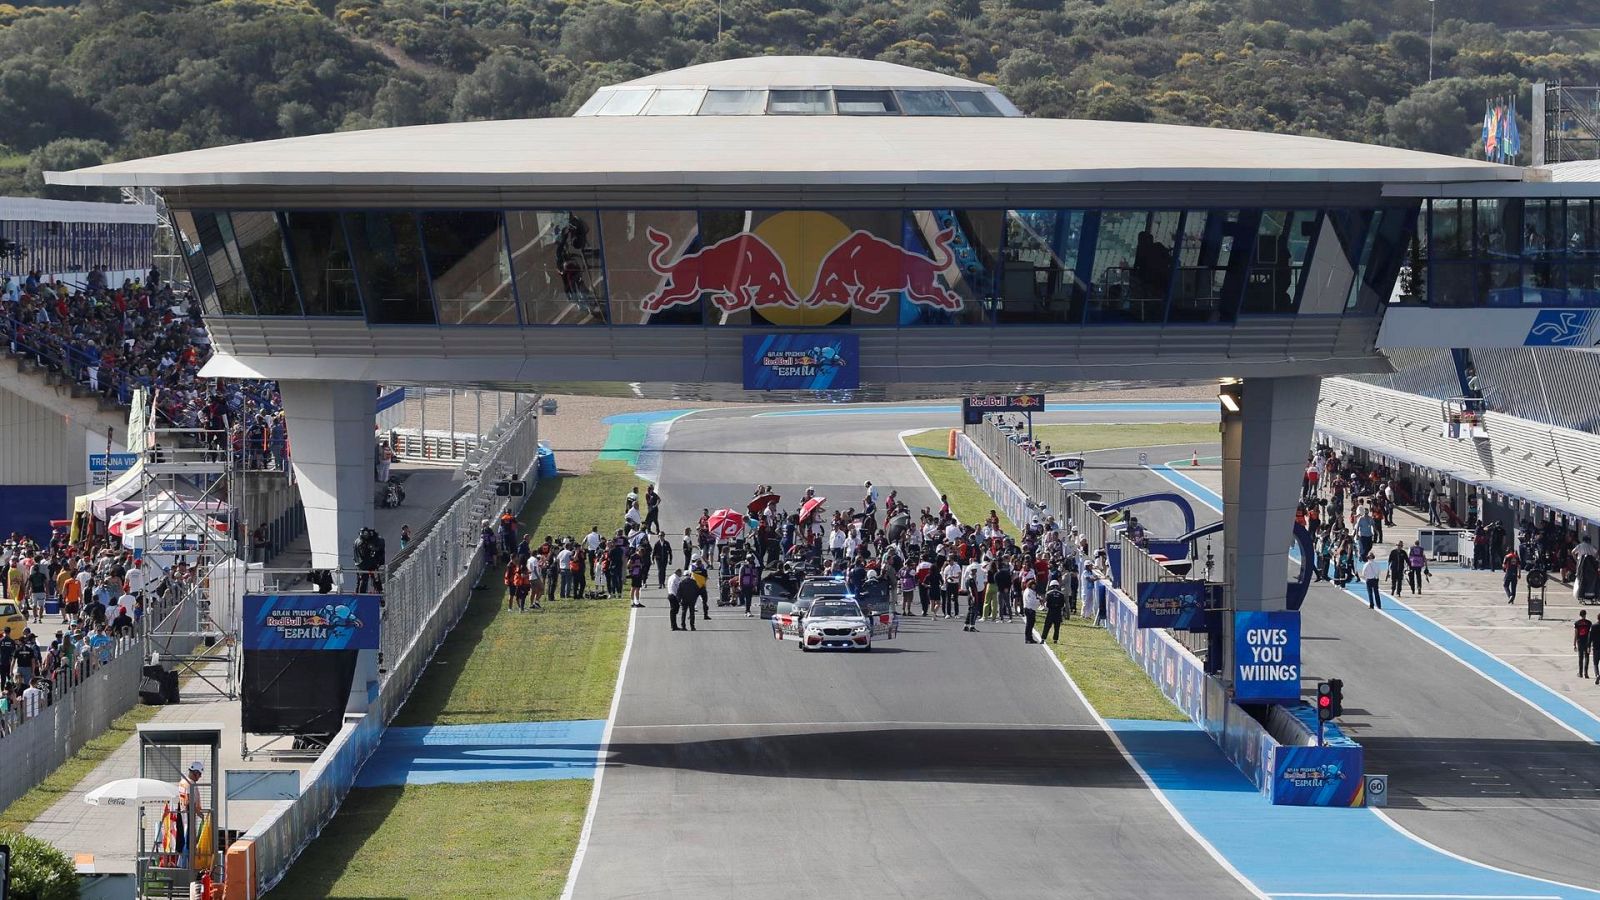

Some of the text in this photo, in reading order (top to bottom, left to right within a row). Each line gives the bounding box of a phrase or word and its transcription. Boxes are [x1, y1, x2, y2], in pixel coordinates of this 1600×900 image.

[778, 366, 815, 376] ESPAÑA
[284, 626, 327, 639] ESPAÑA
[1246, 629, 1288, 645] GIVES
[1251, 646, 1283, 663] YOU
[1239, 664, 1298, 681] WIIINGS
[1370, 782, 1383, 791] 60
